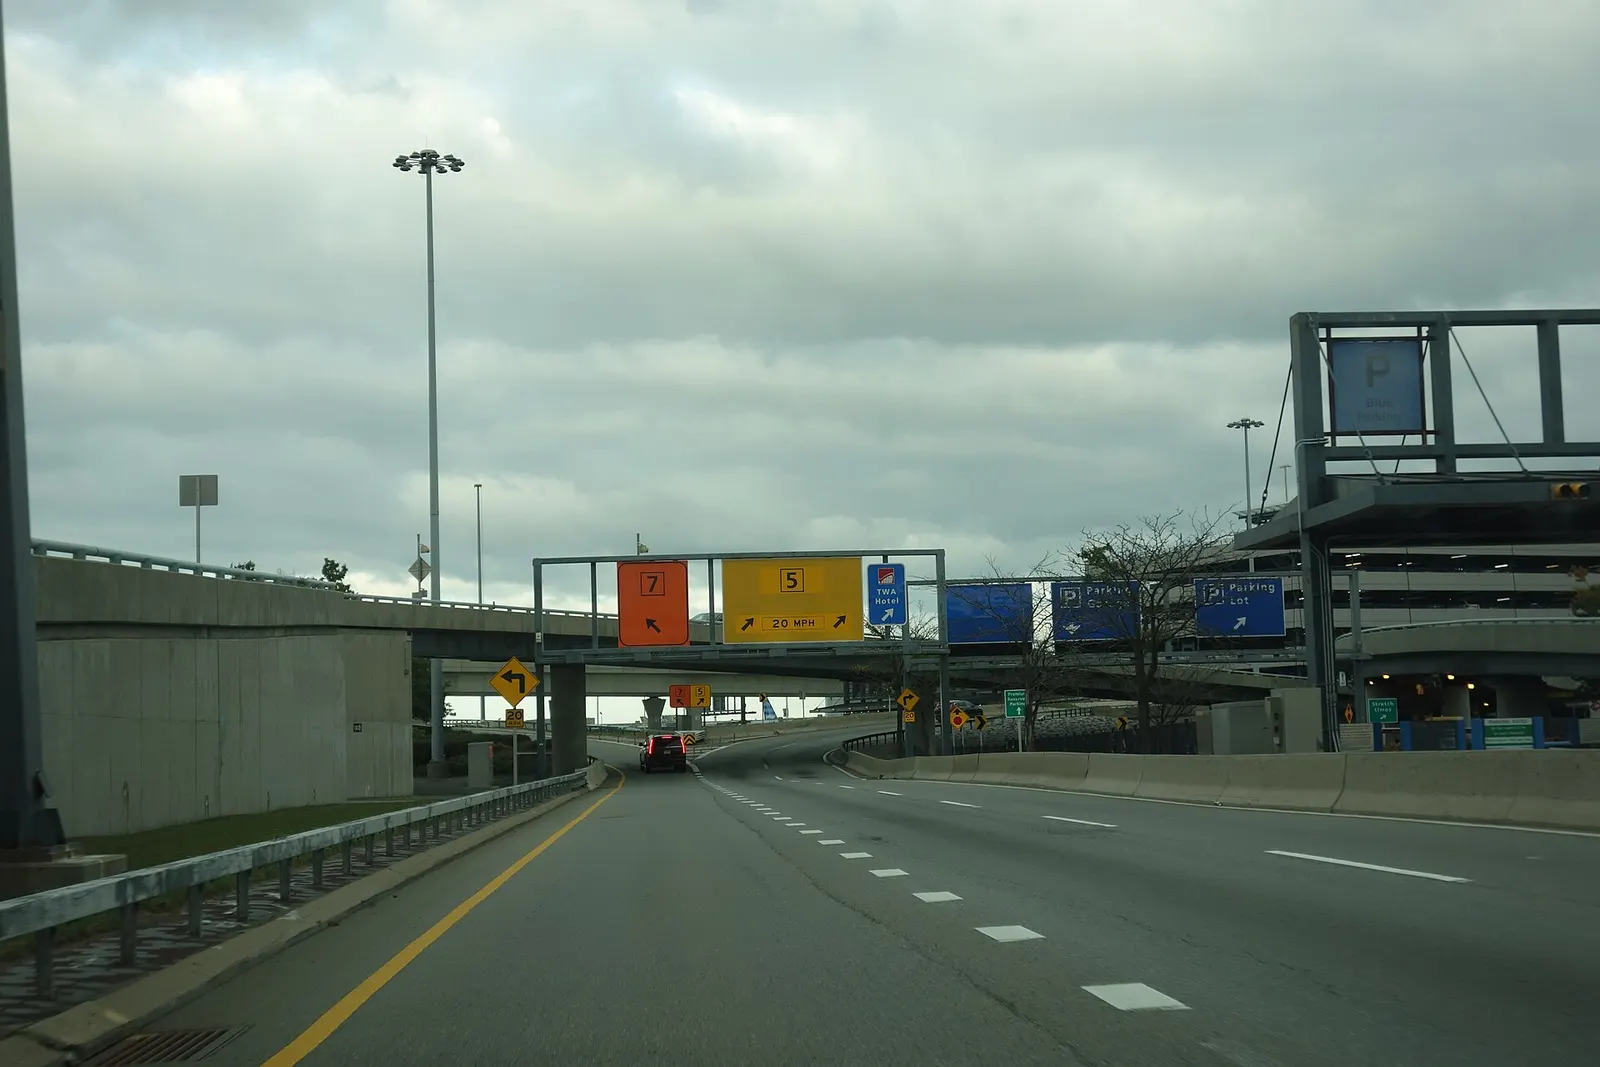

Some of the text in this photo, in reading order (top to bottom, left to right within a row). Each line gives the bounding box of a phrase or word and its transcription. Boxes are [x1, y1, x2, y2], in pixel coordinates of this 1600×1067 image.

[1366, 354, 1390, 387] P
[1366, 398, 1394, 408] Blue
[646, 575, 658, 593] 7
[786, 572, 798, 589] 5
[1229, 582, 1275, 594] Parking
[875, 597, 899, 605] Hotel
[1230, 596, 1249, 605] Lot
[772, 619, 815, 628] 20 MPH
[677, 688, 683, 696] 7
[697, 687, 703, 695] 5
[507, 711, 522, 720] 20
